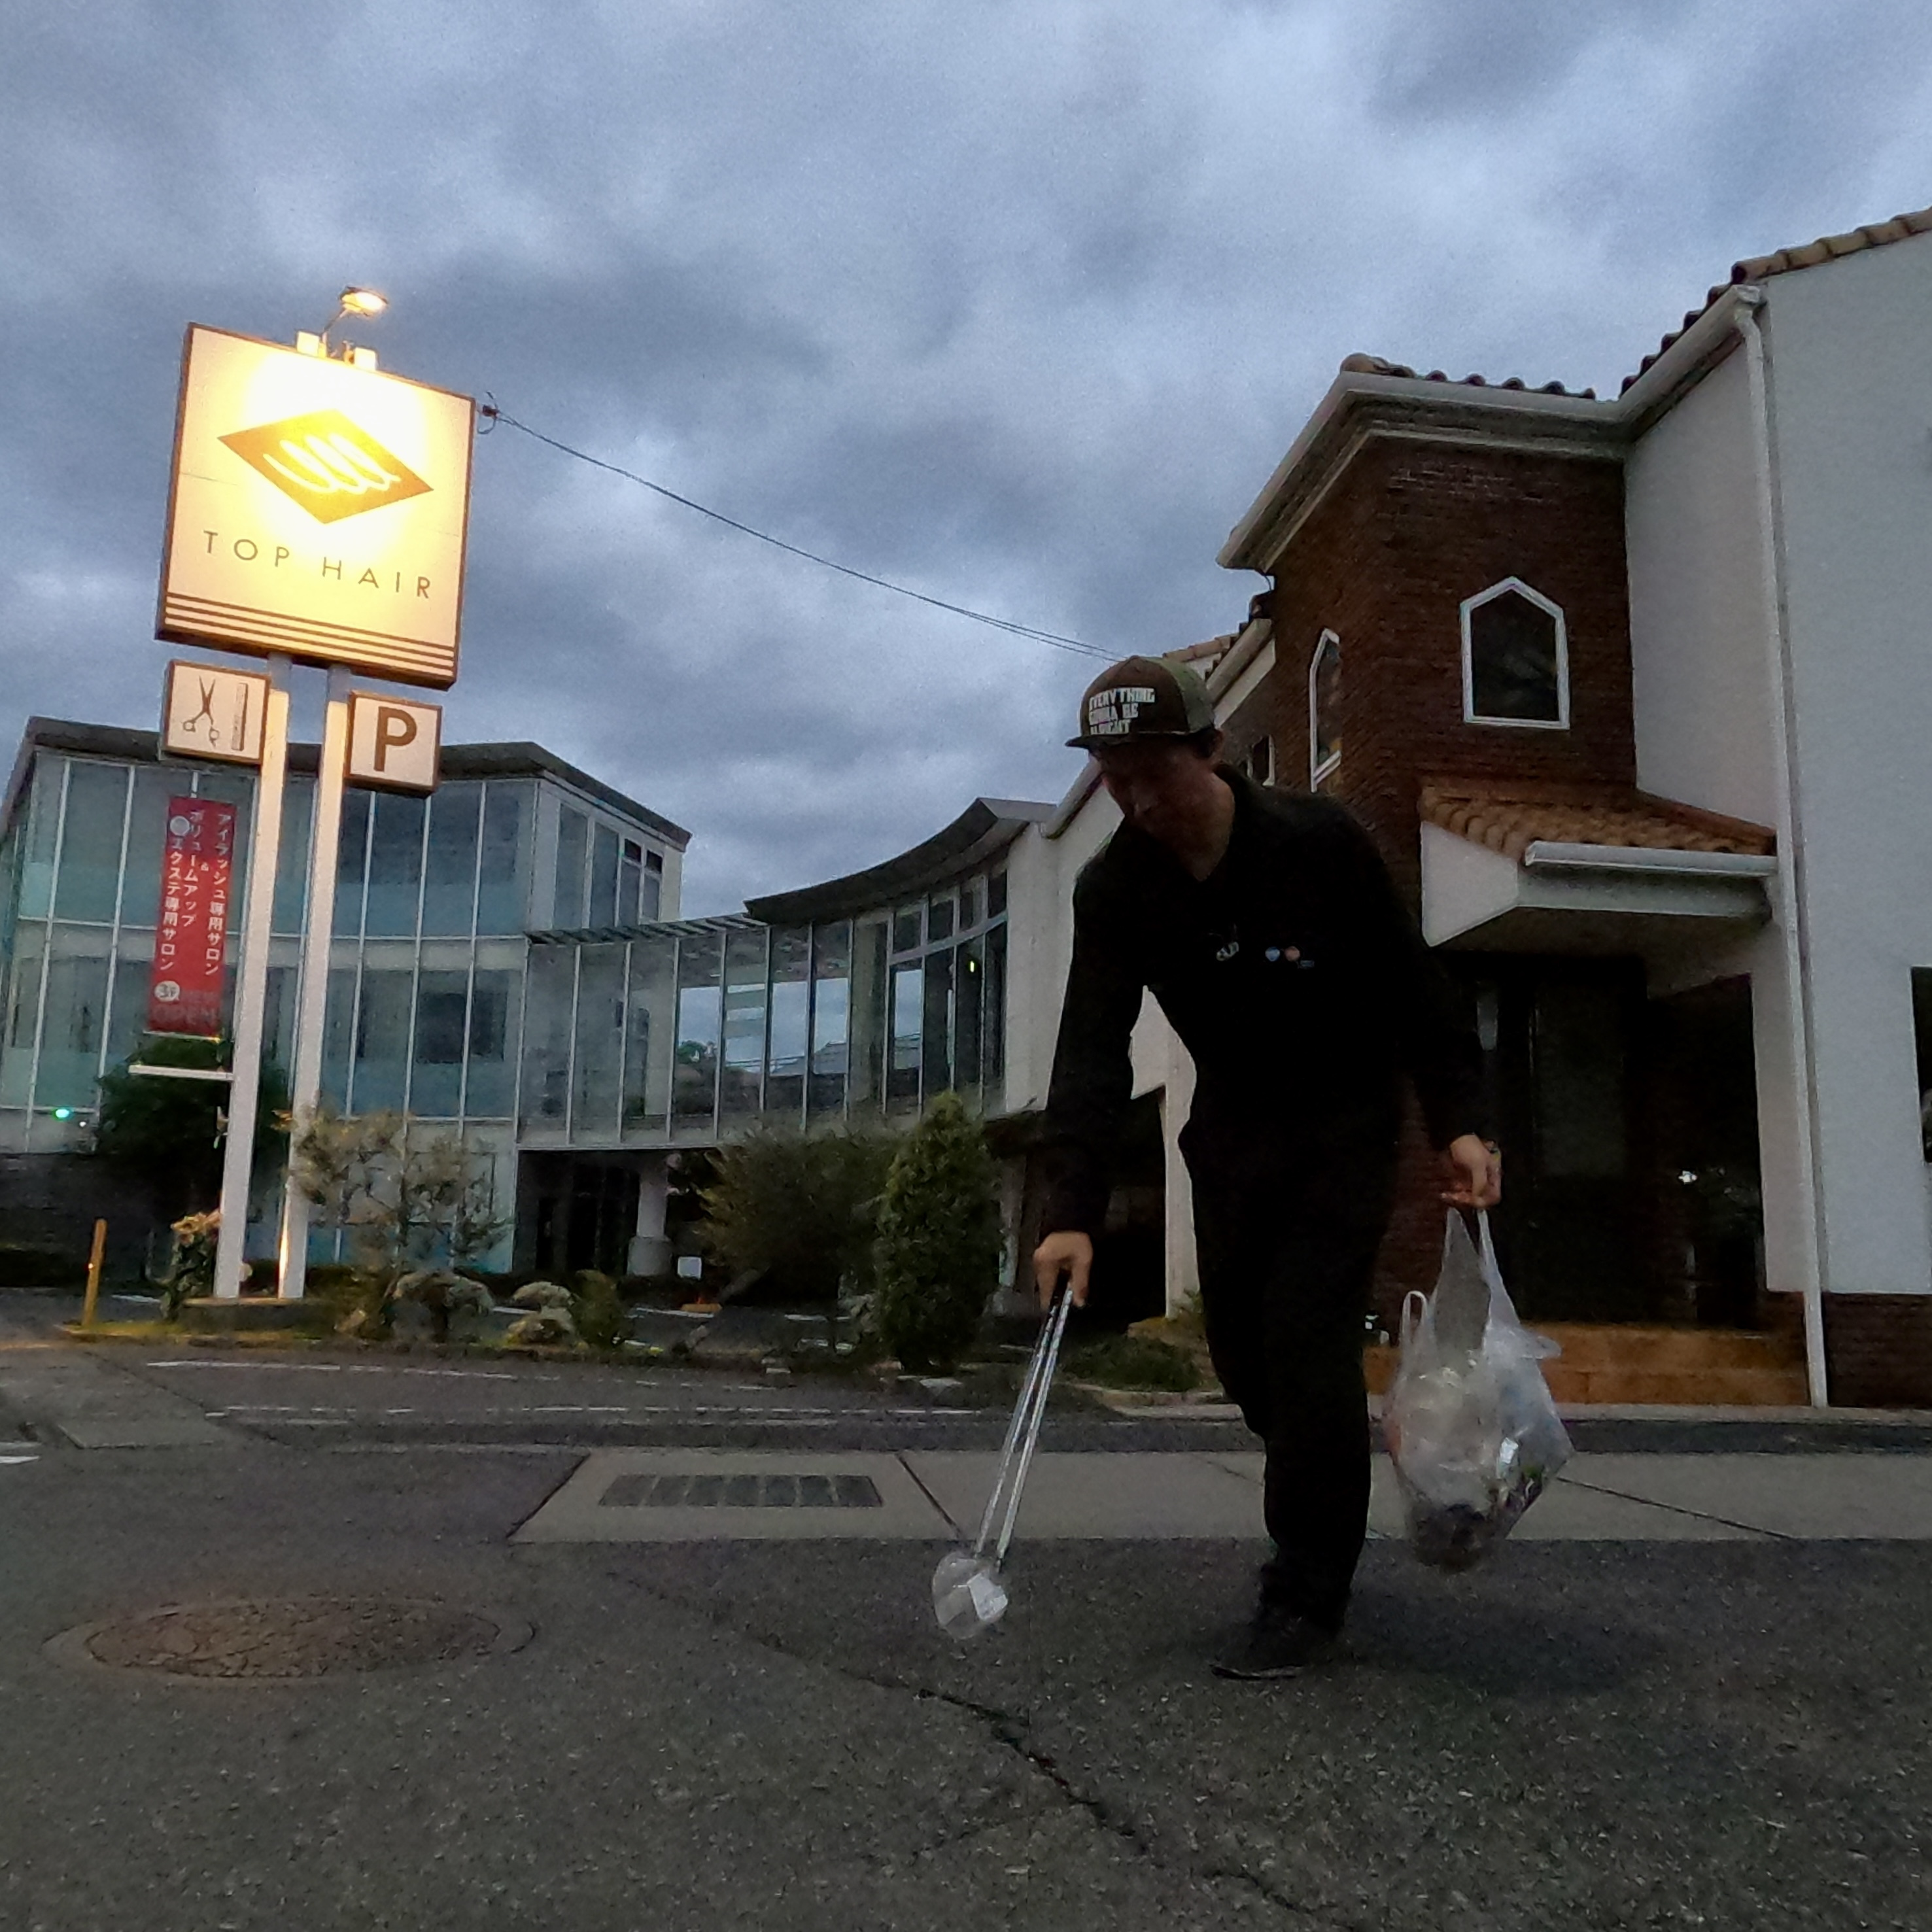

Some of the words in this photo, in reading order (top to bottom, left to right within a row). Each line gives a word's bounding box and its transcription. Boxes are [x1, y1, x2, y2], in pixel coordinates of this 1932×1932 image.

[203, 530, 290, 567] TOP
[322, 557, 432, 600] HAIR
[374, 706, 417, 772] P
